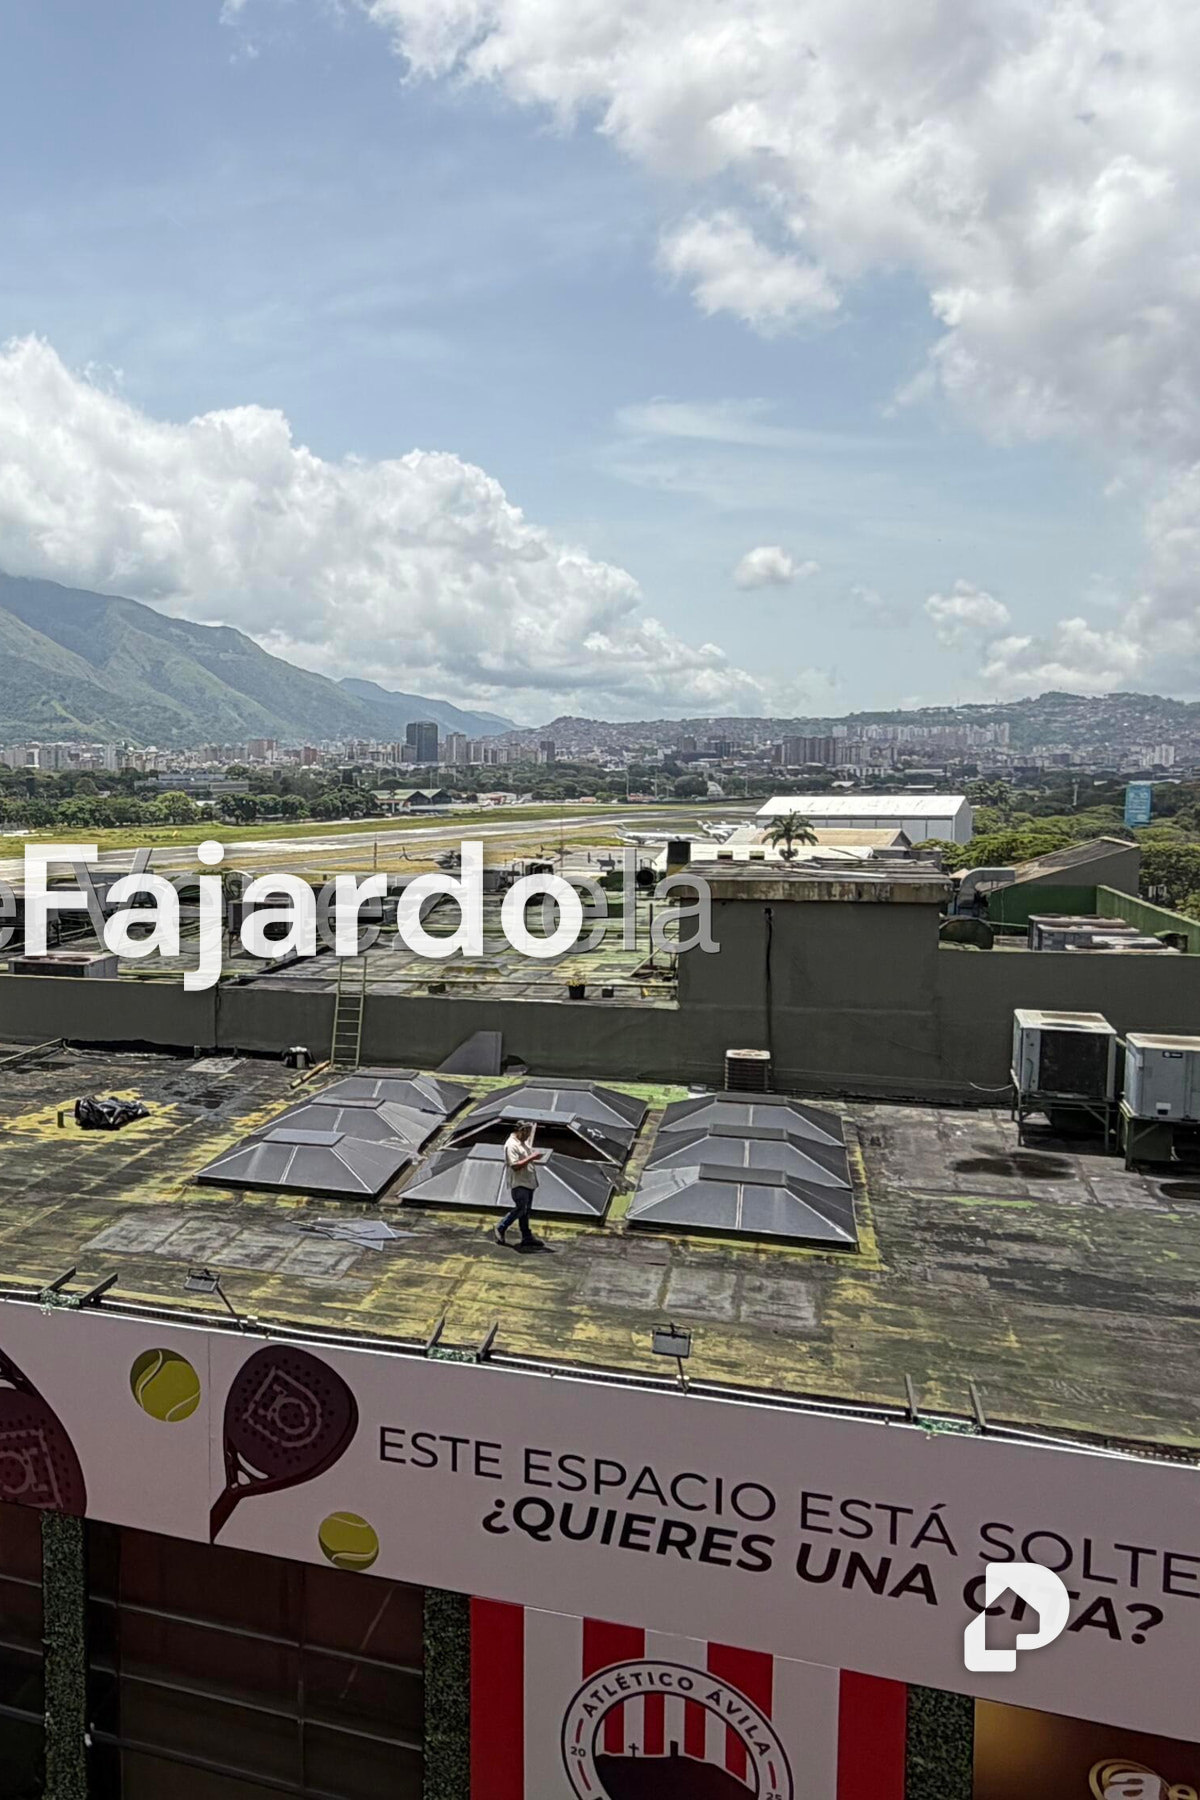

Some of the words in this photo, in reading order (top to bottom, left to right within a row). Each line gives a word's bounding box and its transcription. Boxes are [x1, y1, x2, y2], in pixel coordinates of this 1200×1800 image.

[379, 1425, 503, 1480] ESTE
[523, 1447, 777, 1523] ESPACIO
[799, 1490, 959, 1557] ESTÁ
[481, 1496, 777, 1573] ¿QUIERES
[795, 1542, 939, 1606] UNA
[962, 1574, 1164, 1645] CIA?
[570, 1746, 587, 1758] 20
[581, 1671, 695, 1719] ATLÉTICO
[705, 1688, 772, 1757] ÁVILA
